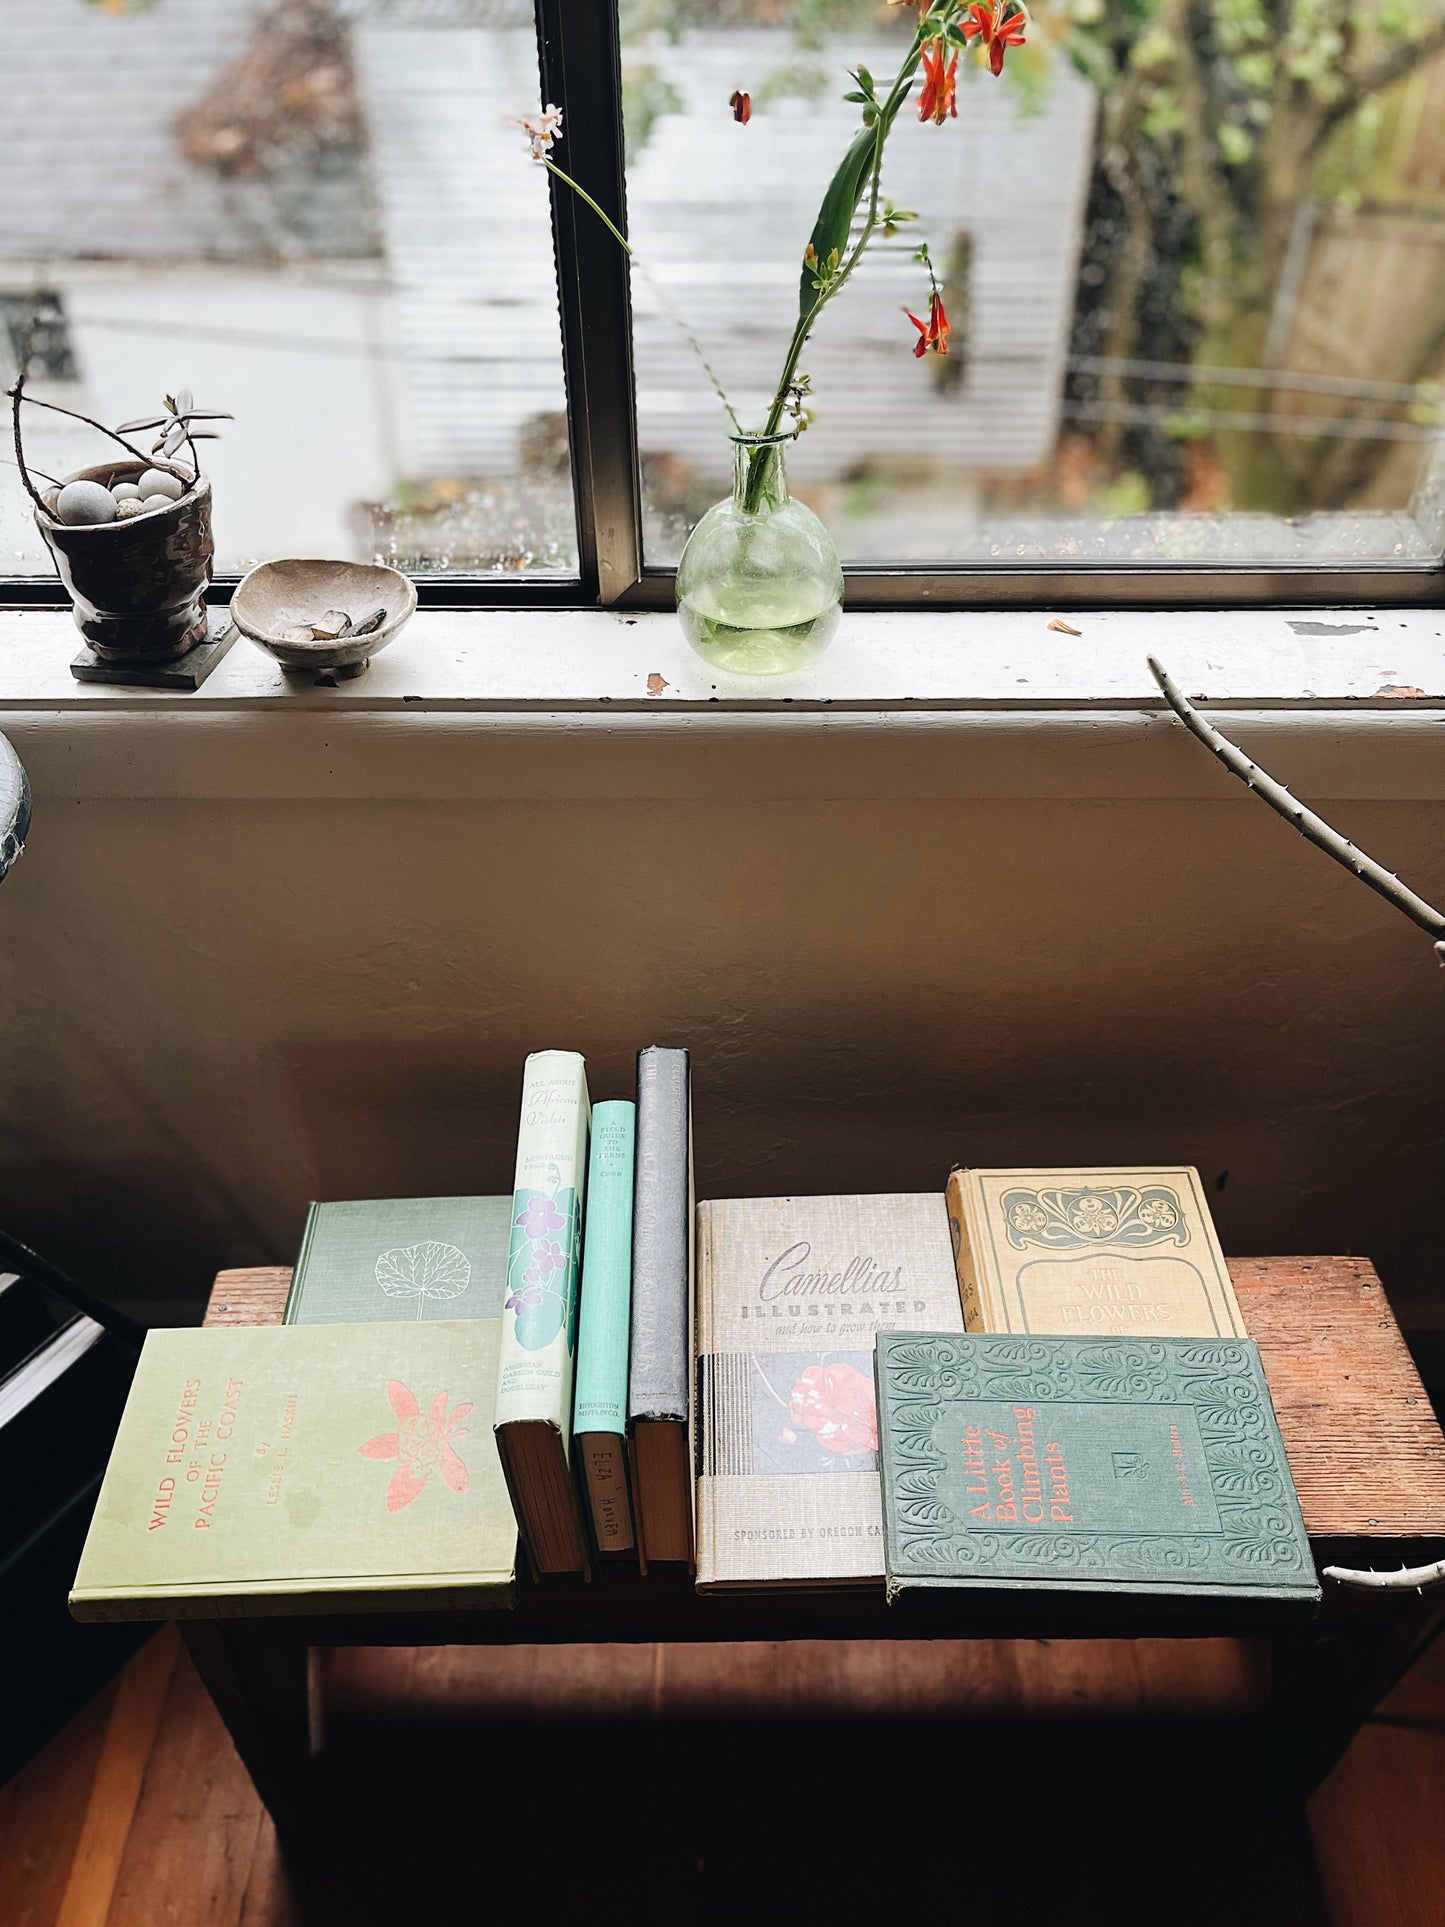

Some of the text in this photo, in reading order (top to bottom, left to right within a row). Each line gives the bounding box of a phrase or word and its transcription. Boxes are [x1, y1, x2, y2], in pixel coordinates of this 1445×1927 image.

[759, 1241, 907, 1302] Camellias
[1088, 1267, 1121, 1281] THE
[1077, 1281, 1143, 1302] WILD
[741, 1300, 927, 1319] ILLUSTRATED
[1060, 1302, 1173, 1323] FLOWERS
[775, 1319, 896, 1336] and how to grow them
[503, 1361, 544, 1373] AMERICAN
[536, 1369, 561, 1378] GUILD
[501, 1378, 518, 1387] AND
[577, 1409, 608, 1418] MIFFLIN
[578, 1402, 620, 1410] HOUGHTON
[148, 1379, 201, 1531] WILD FLOWERS
[186, 1420, 213, 1482] OF THE
[195, 1378, 244, 1529] PACIFIC COAST
[592, 1452, 613, 1481] ELZA
[961, 1425, 992, 1522] A Little
[984, 1427, 1018, 1523] Book of
[1012, 1406, 1045, 1524] Climbing
[266, 1465, 284, 1505] LESLIE
[1045, 1441, 1073, 1523] Plants
[734, 1525, 883, 1541] SPONSORED BY OREGON CA
